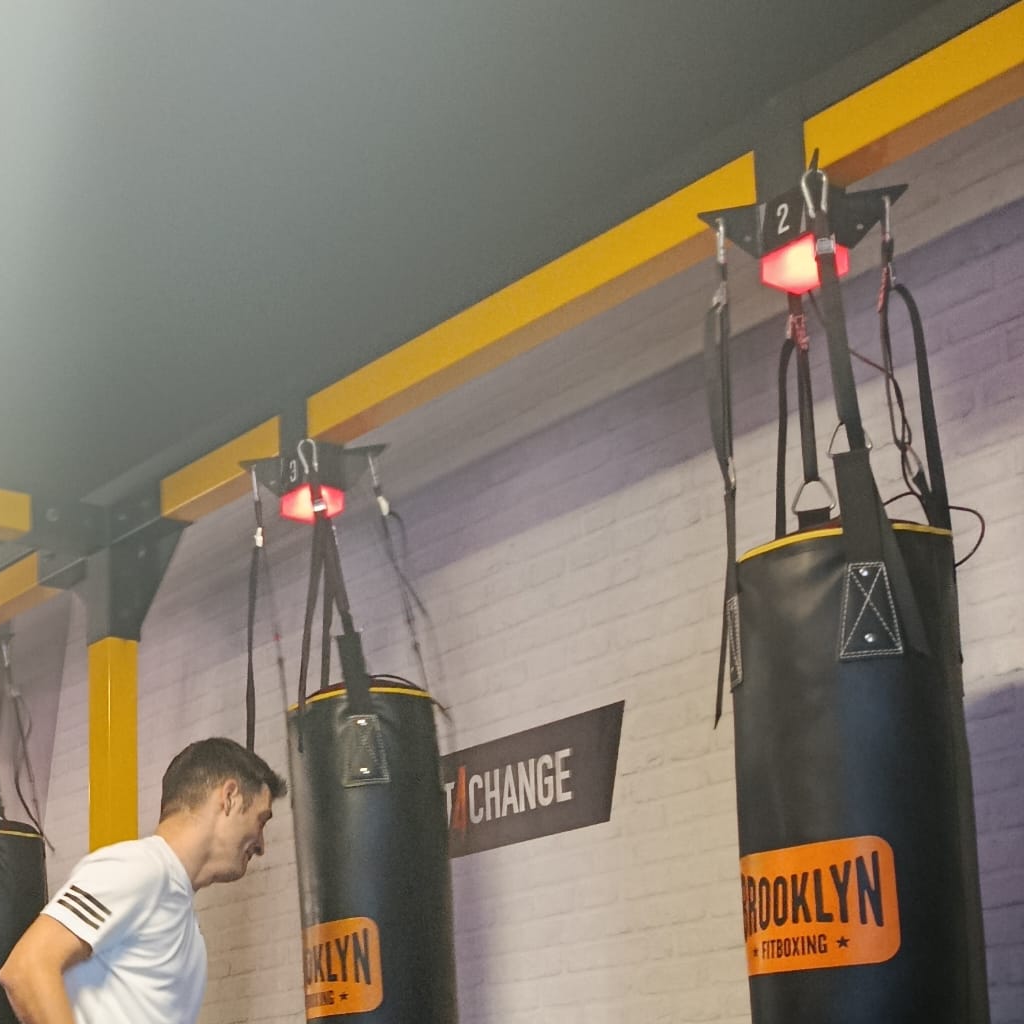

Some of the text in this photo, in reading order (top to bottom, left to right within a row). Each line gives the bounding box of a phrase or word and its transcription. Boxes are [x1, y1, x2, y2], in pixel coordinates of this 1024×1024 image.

[776, 203, 789, 234] 2
[289, 459, 297, 482] 3
[762, 934, 828, 959] FITBOXING
